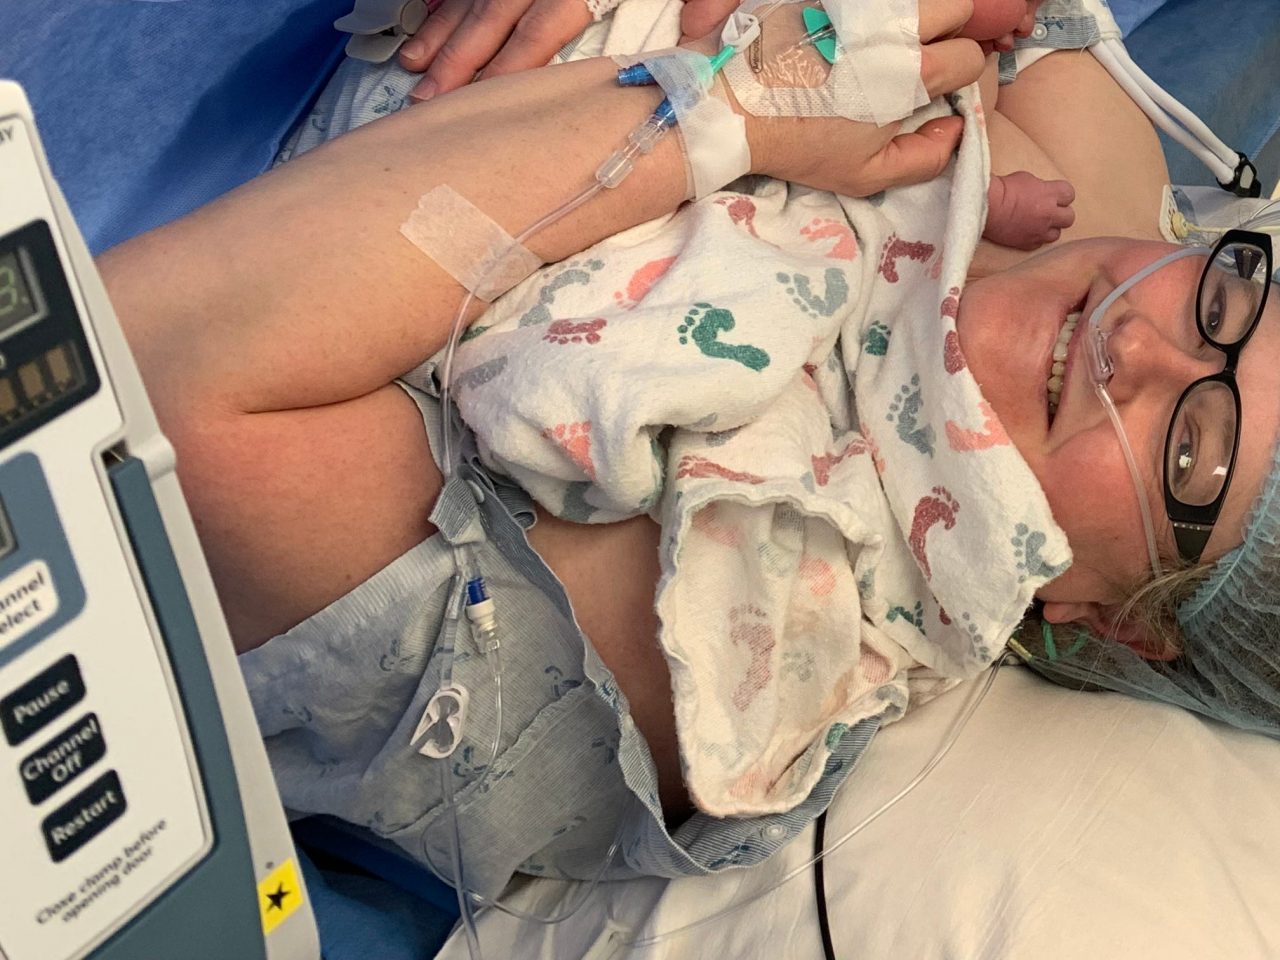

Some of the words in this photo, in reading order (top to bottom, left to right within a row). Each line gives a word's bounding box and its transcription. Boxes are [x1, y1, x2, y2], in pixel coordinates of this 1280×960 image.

[13, 679, 70, 725] Pause
[22, 718, 98, 781] Channel
[52, 750, 83, 782] Off
[51, 790, 118, 845] Restart
[36, 891, 76, 924] Close
[124, 819, 167, 858] before
[62, 874, 121, 923] opening
[123, 846, 152, 876] door
